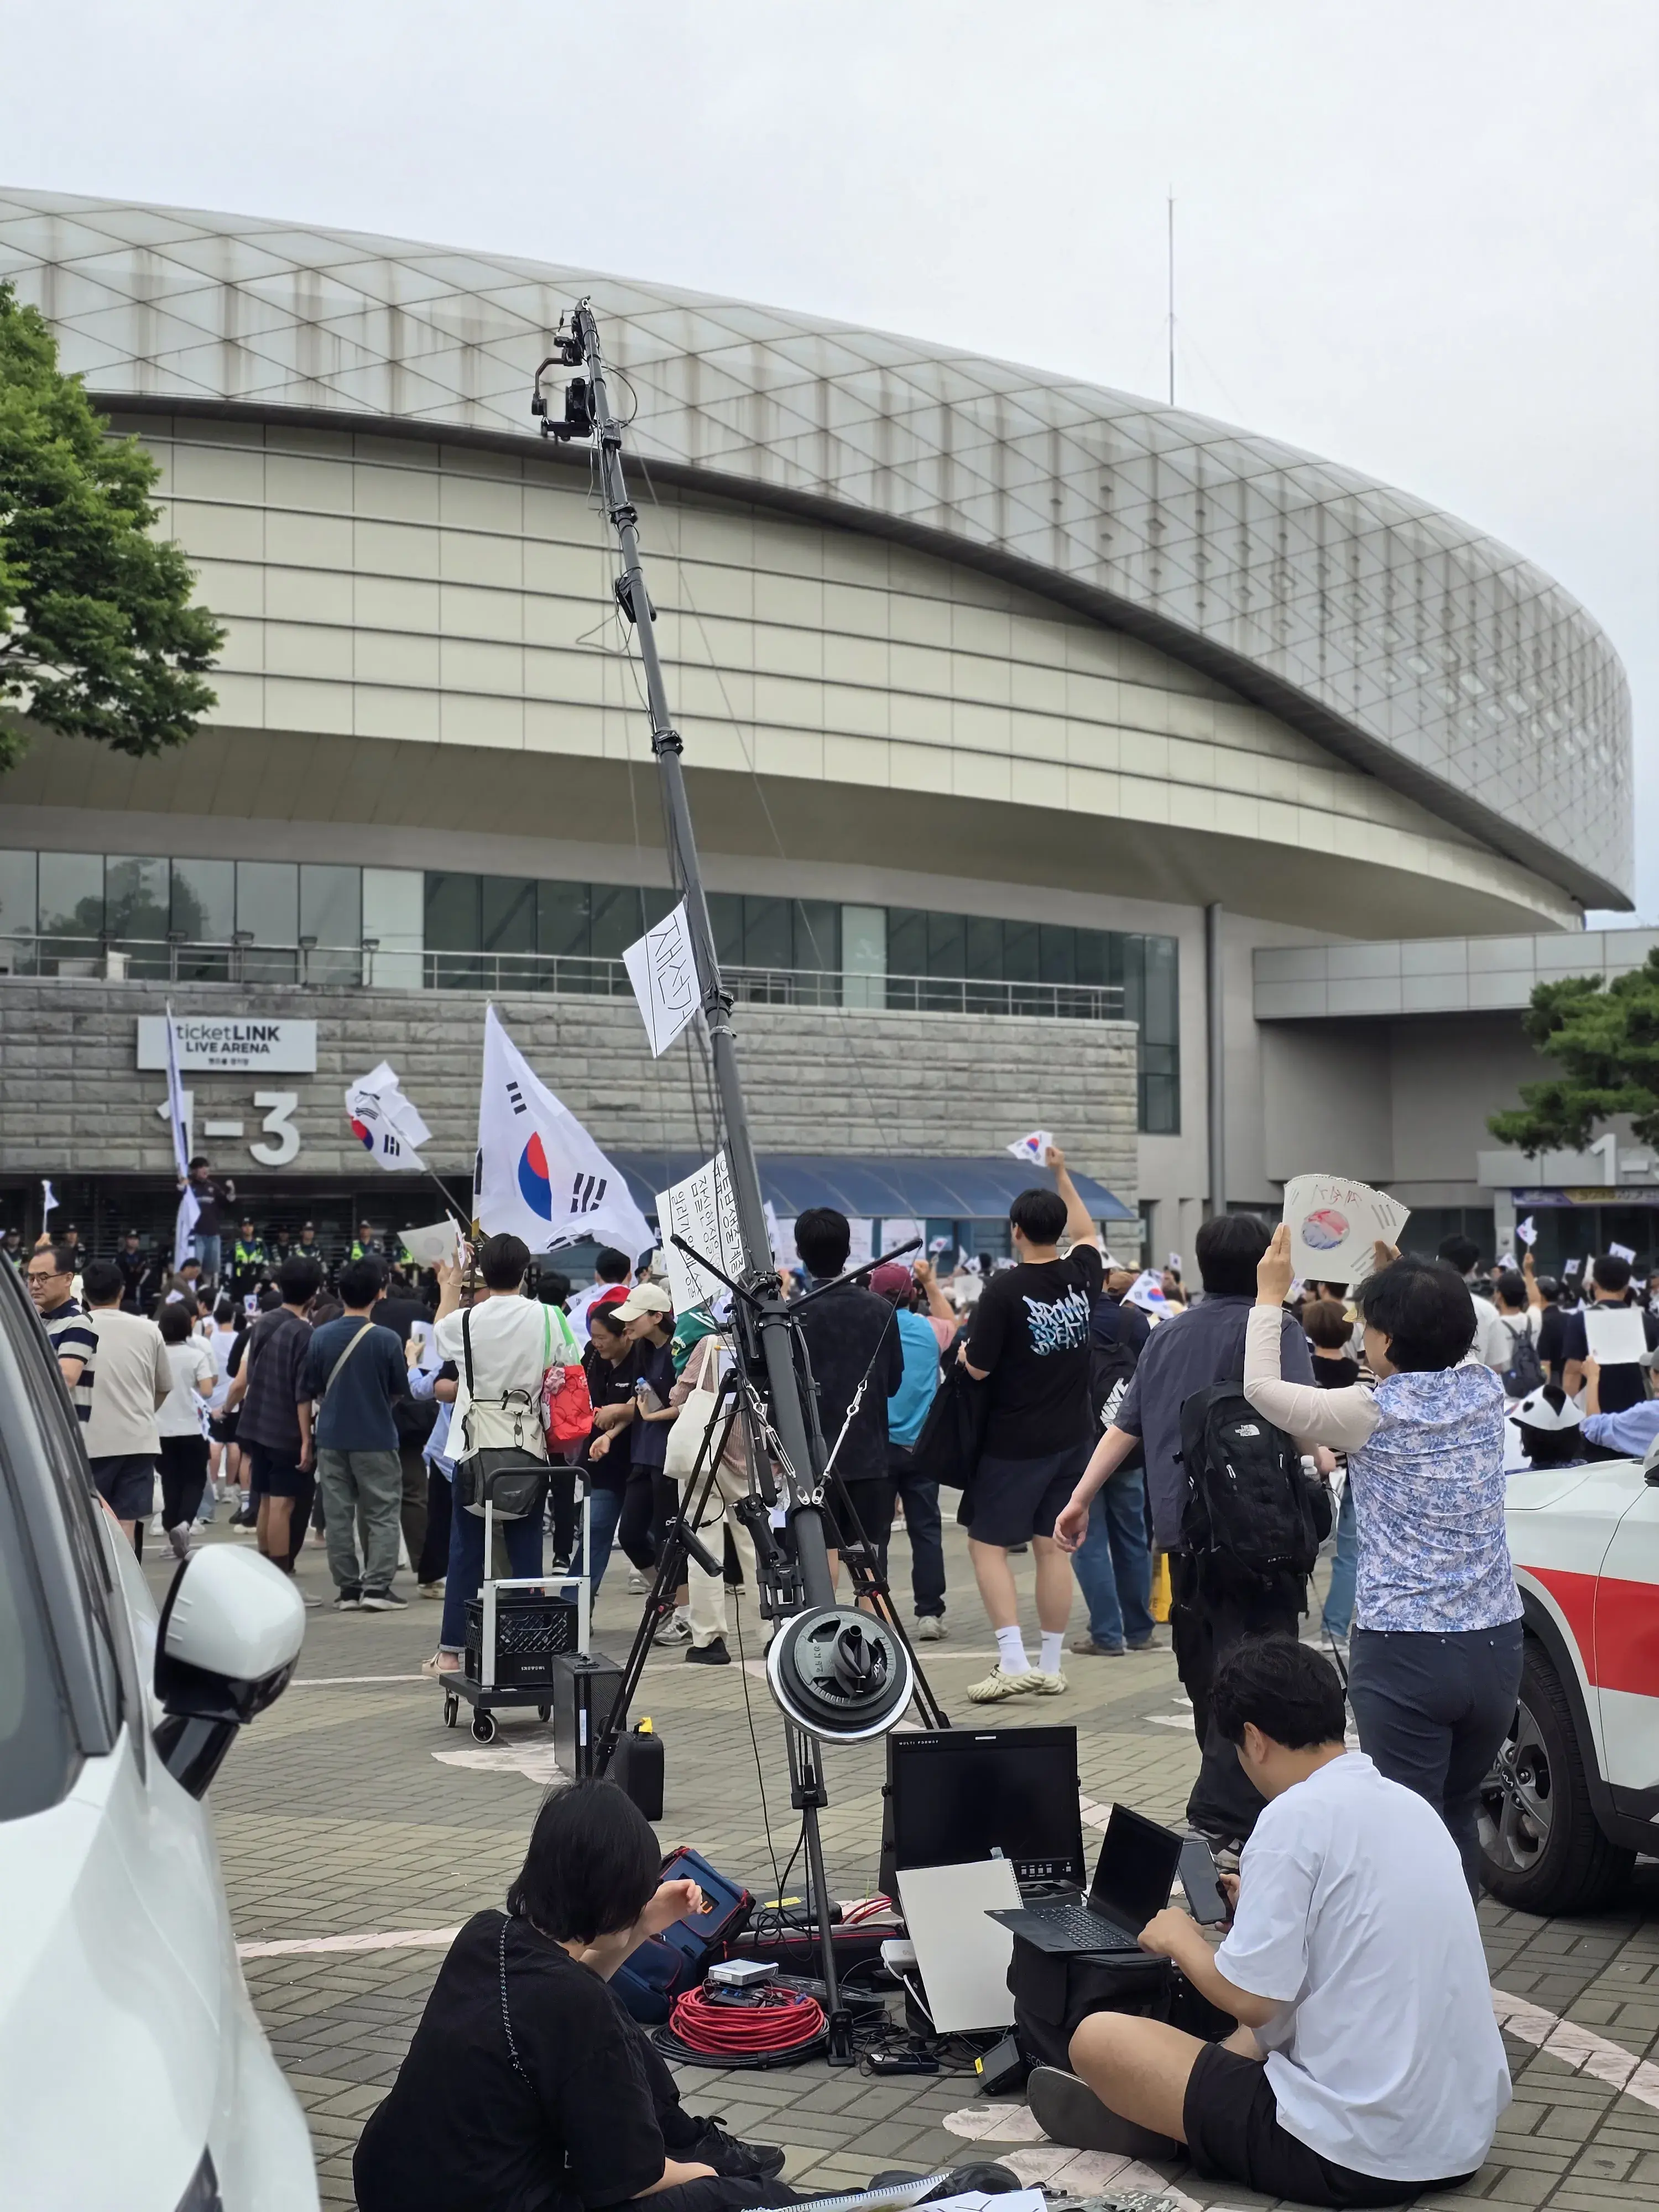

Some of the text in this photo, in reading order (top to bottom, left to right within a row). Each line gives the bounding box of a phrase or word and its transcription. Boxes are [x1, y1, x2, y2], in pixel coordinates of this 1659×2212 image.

[650, 914, 694, 1036] 재선거
[176, 1024, 280, 1041] ticketLINK
[186, 1042, 270, 1053] LIVE ARENA
[1589, 1133, 1659, 1187] 1-
[671, 1191, 691, 1233] 알리기
